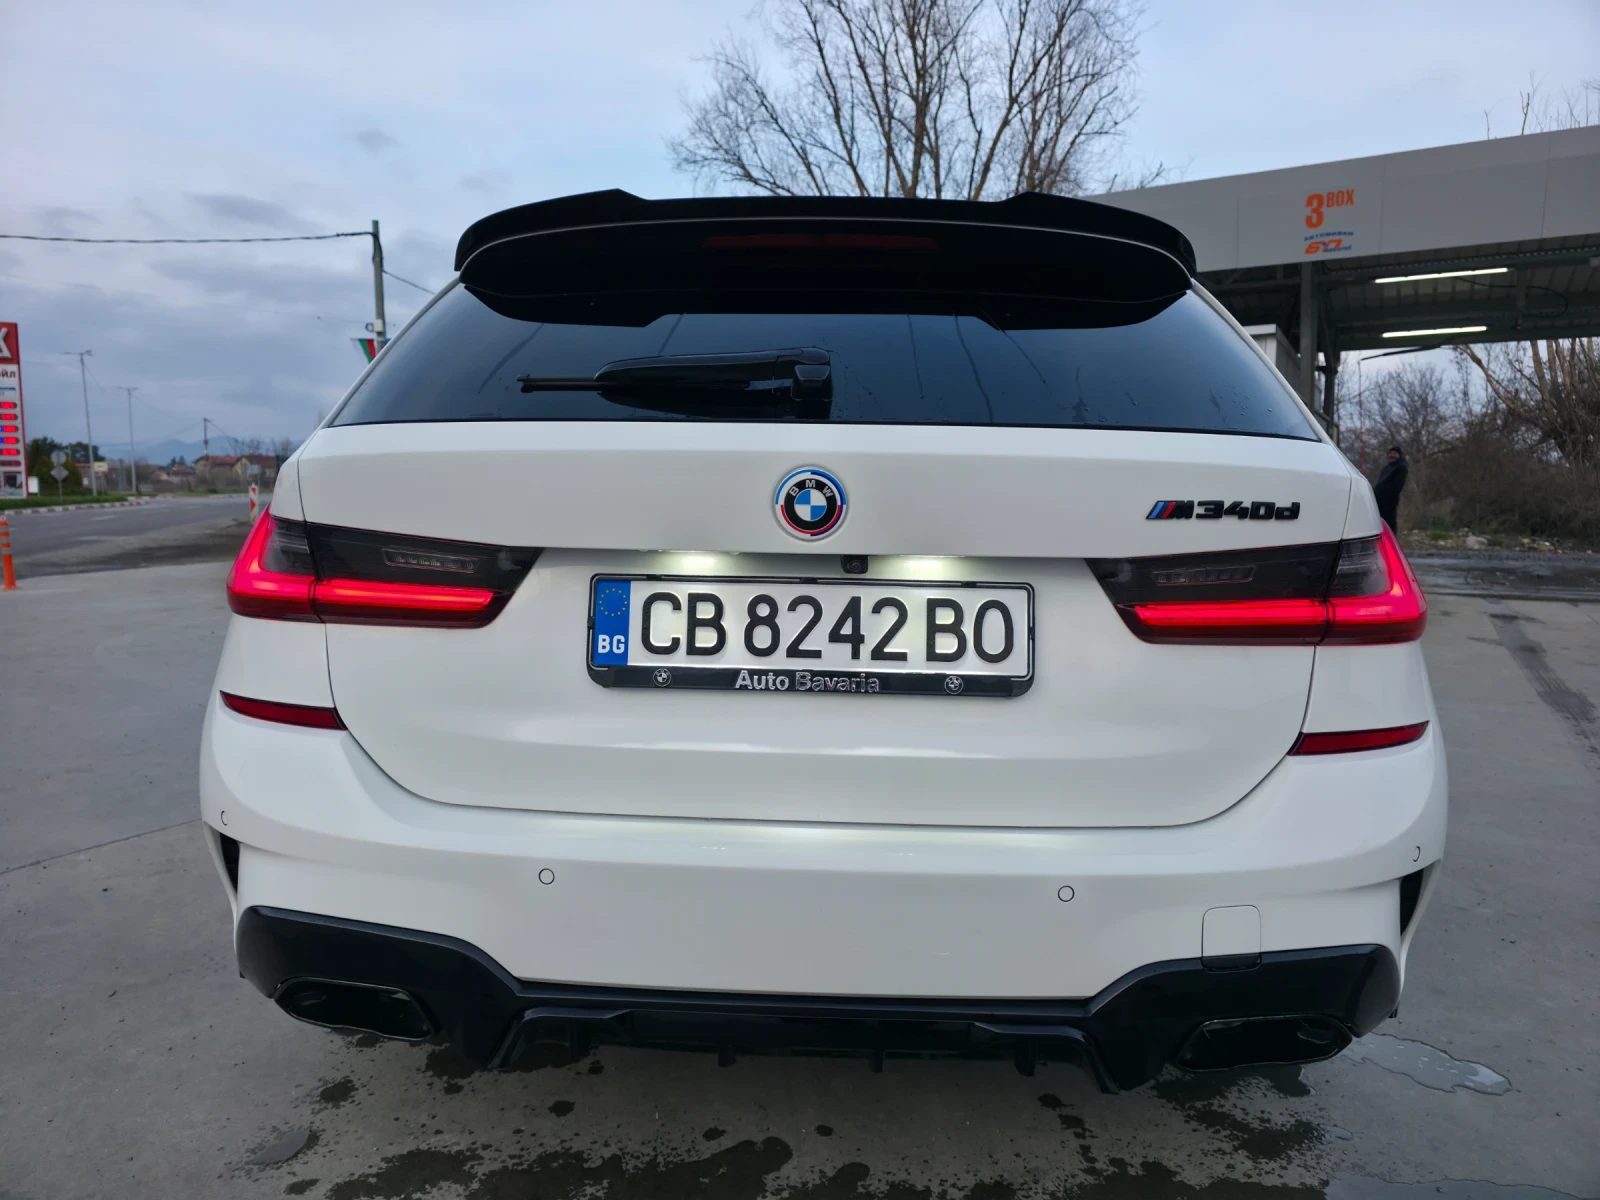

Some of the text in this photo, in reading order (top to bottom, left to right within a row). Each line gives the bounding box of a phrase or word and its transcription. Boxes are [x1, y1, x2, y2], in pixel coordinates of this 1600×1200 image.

[1305, 188, 1355, 229] 3 BOX
[788, 479, 834, 498] BMW
[641, 591, 727, 656] CB
[743, 593, 909, 662] 8242
[598, 633, 626, 655] BG
[735, 670, 880, 694] Auto Bavaria
